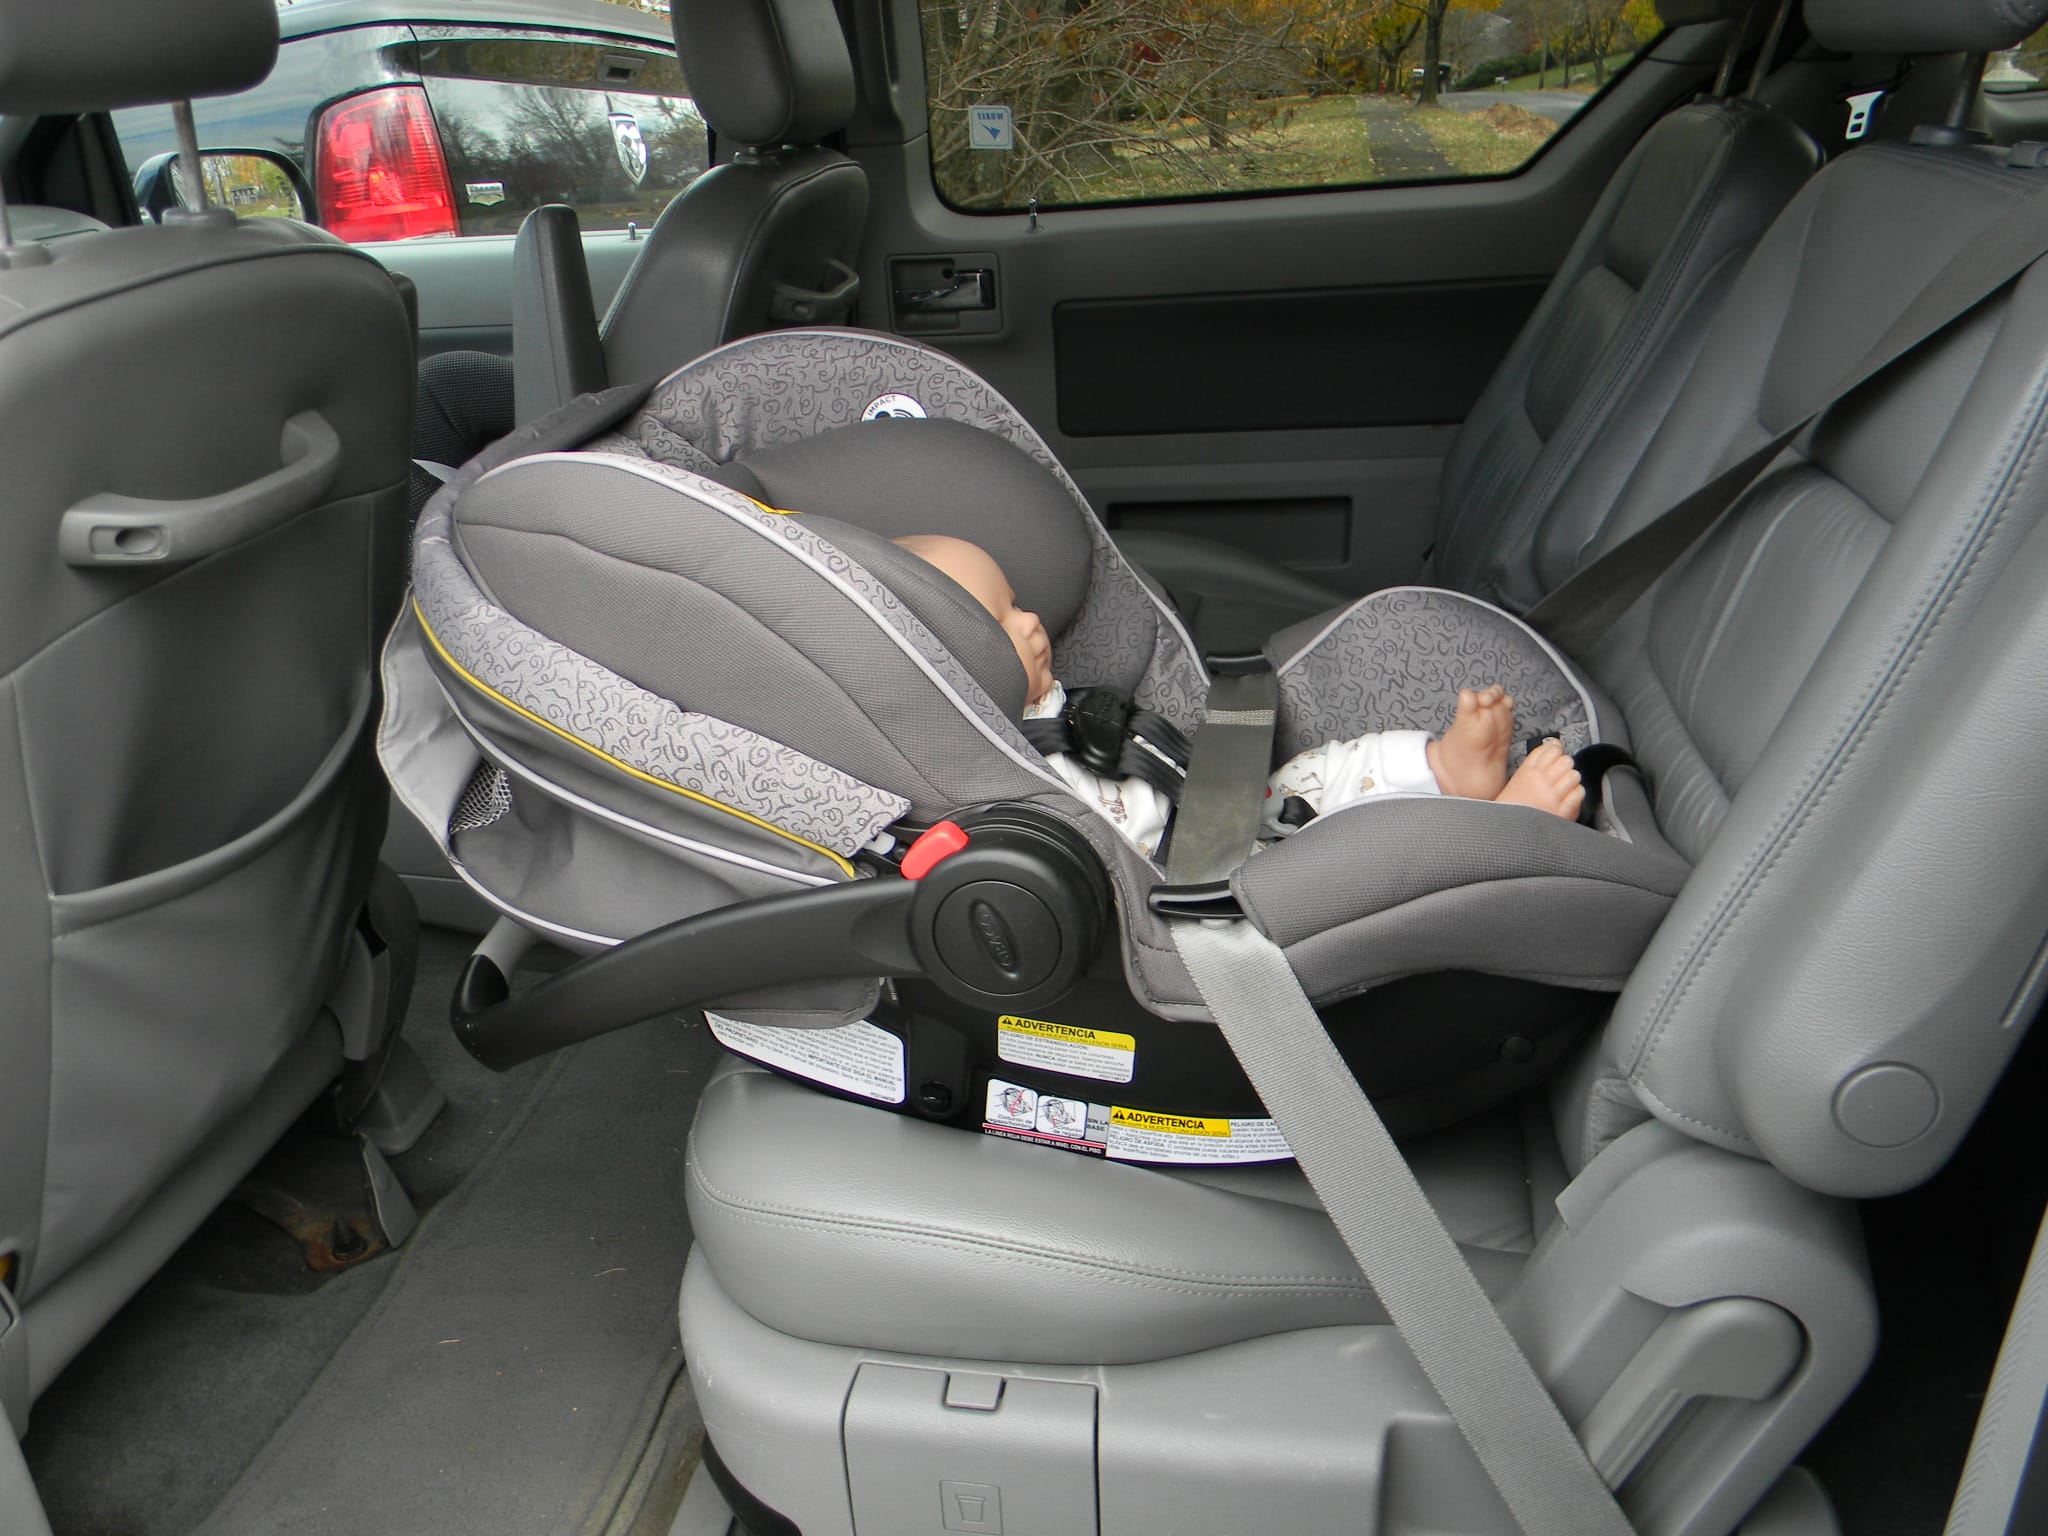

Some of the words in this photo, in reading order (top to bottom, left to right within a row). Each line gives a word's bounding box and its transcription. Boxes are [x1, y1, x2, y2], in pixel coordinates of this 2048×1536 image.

[867, 396, 897, 415] IMPACT
[1015, 1019, 1096, 1039] ADVERTENCIA
[1127, 1112, 1205, 1129] ADVERTENCIA
